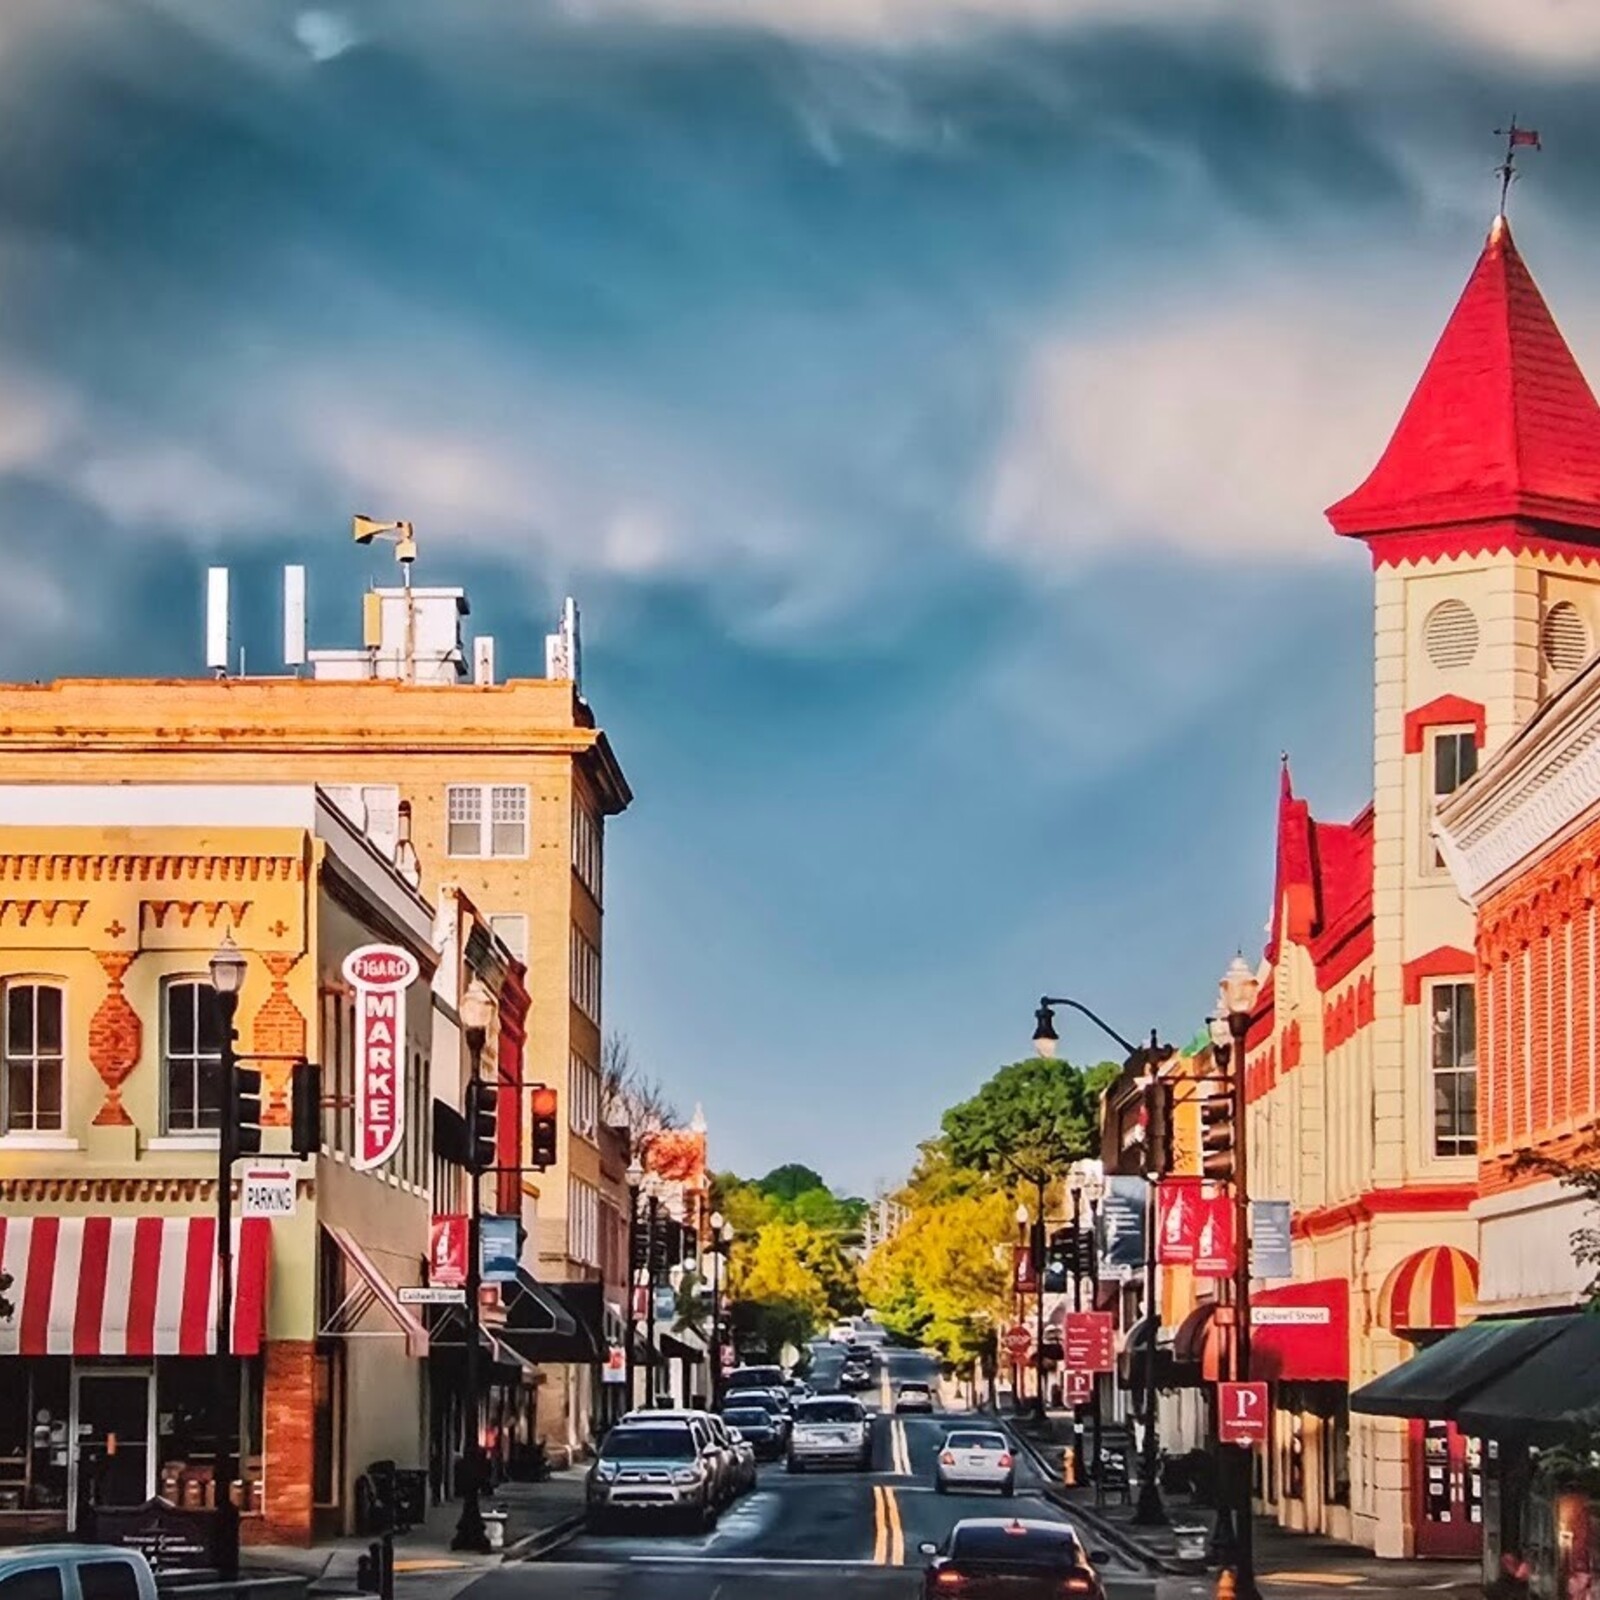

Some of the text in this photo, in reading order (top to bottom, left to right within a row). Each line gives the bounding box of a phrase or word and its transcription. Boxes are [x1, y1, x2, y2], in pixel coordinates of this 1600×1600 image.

[354, 959, 407, 977] FIGARO
[366, 995, 394, 1147] MARKET
[248, 1187, 291, 1210] PARKING
[403, 1291, 463, 1300] Caldwell Street
[1255, 1310, 1324, 1321] Caldwell Street
[1075, 1376, 1085, 1391] P
[1236, 1390, 1258, 1418] P
